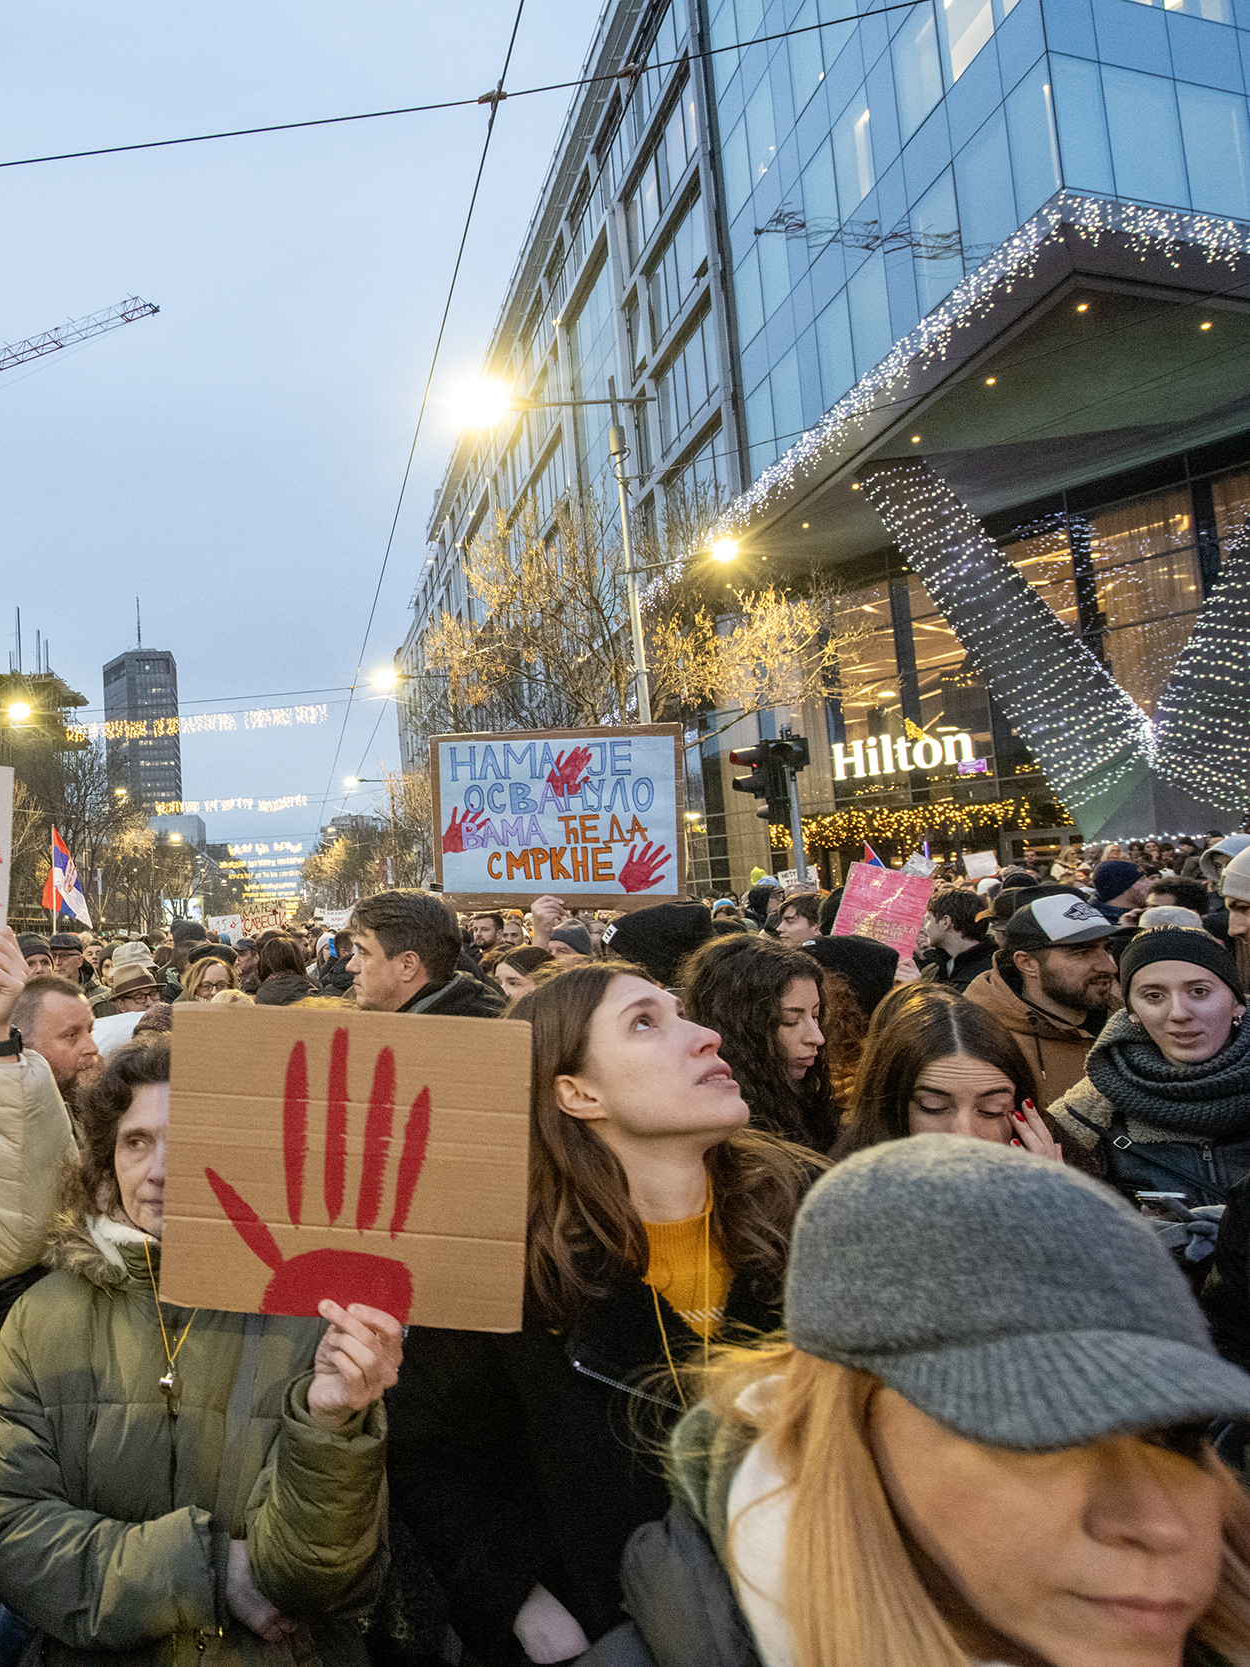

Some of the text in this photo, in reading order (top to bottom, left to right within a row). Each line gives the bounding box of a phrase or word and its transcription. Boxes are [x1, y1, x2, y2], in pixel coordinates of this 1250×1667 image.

[449, 740, 632, 782] НАМА ЈЕ
[831, 733, 975, 781] Hilton
[464, 777, 654, 815] ОСВАНУЛО
[461, 814, 548, 850] ВАМА
[487, 847, 616, 882] СМРКНЕ
